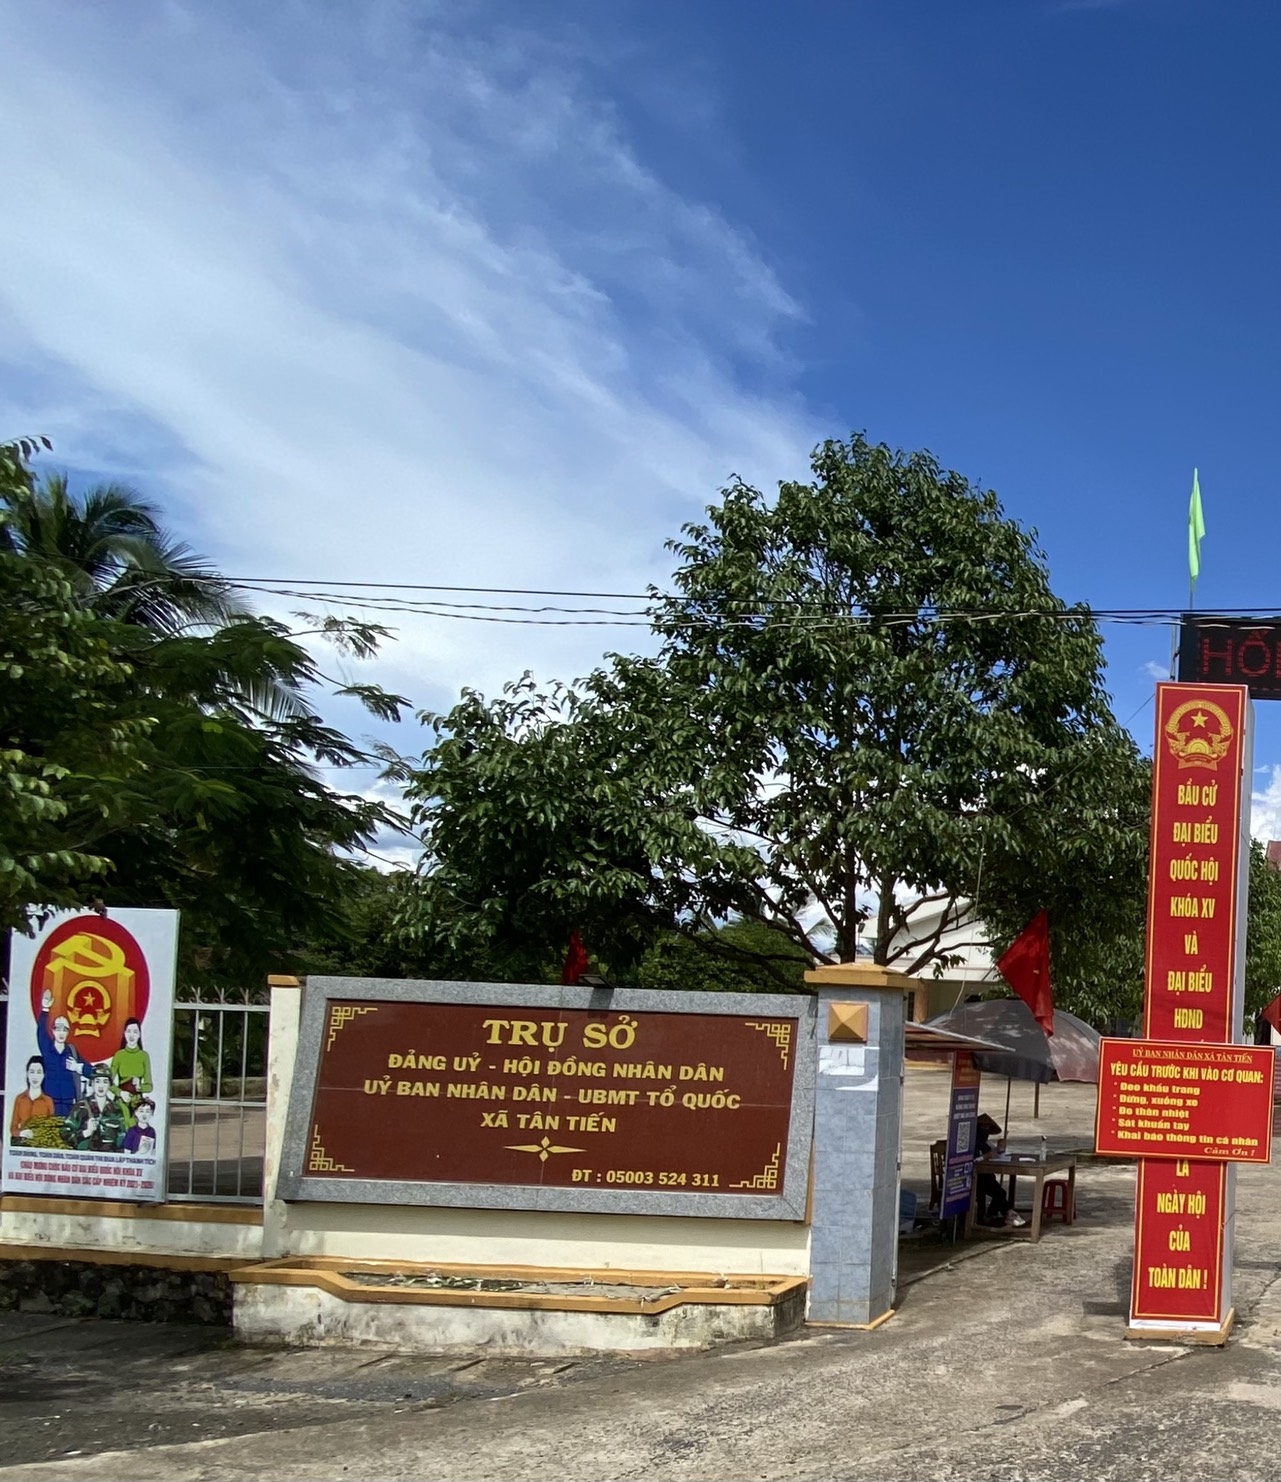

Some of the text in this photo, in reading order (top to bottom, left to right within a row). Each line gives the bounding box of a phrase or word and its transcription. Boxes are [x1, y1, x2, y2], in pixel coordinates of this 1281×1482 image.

[1178, 778, 1218, 806] BẦU CỬ
[1173, 816, 1218, 846] ĐẠI BIỂU
[1170, 853, 1218, 885] QUỐC HỘI
[1170, 893, 1215, 918] KHÓA XV
[1185, 931, 1198, 954] VÀ
[1168, 964, 1212, 995] ĐẠI BIỂU
[1174, 1008, 1203, 1029] HĐND
[483, 1016, 637, 1050] TRỤ SỞ
[388, 1050, 446, 1072] ĐẢNG
[453, 1051, 481, 1072] UỶ
[503, 1058, 540, 1078] HỘI
[547, 1055, 606, 1079] ĐỒNG
[613, 1059, 672, 1080] NHÂN
[679, 1061, 724, 1081] DÂN
[1145, 1049, 1161, 1057] BAN
[1111, 1061, 1128, 1076] YÊU
[1151, 1064, 1181, 1078] TRƯỚC
[1183, 1067, 1198, 1079] KHI
[1201, 1066, 1219, 1080] VÀO
[1221, 1069, 1234, 1081] CƠ
[1236, 1070, 1263, 1083] QUAN:
[364, 1075, 392, 1096] UỶ
[397, 1082, 440, 1098] BAN
[447, 1078, 505, 1101] NHÂN
[513, 1080, 557, 1103] DÂN
[578, 1089, 637, 1106] UBMT
[647, 1085, 677, 1107] TỔ
[683, 1087, 740, 1110] QUỐC
[481, 1110, 616, 1133] XÃ TÂN TIẾN
[1118, 1131, 1141, 1139] Khai
[1144, 1132, 1163, 1140] báo
[1166, 1133, 1196, 1143] thông
[1199, 1135, 1213, 1143] tin
[1232, 1137, 1258, 1146] nhân
[572, 1169, 592, 1182] ĐT
[606, 1169, 653, 1185] 05003
[658, 1171, 687, 1186] 524
[691, 1172, 719, 1187] 311
[1157, 1189, 1205, 1218] NGÀY HỘI
[1169, 1224, 1190, 1251] CỦA
[1148, 1263, 1176, 1288] TOÀN
[1178, 1264, 1200, 1289] DÂN
